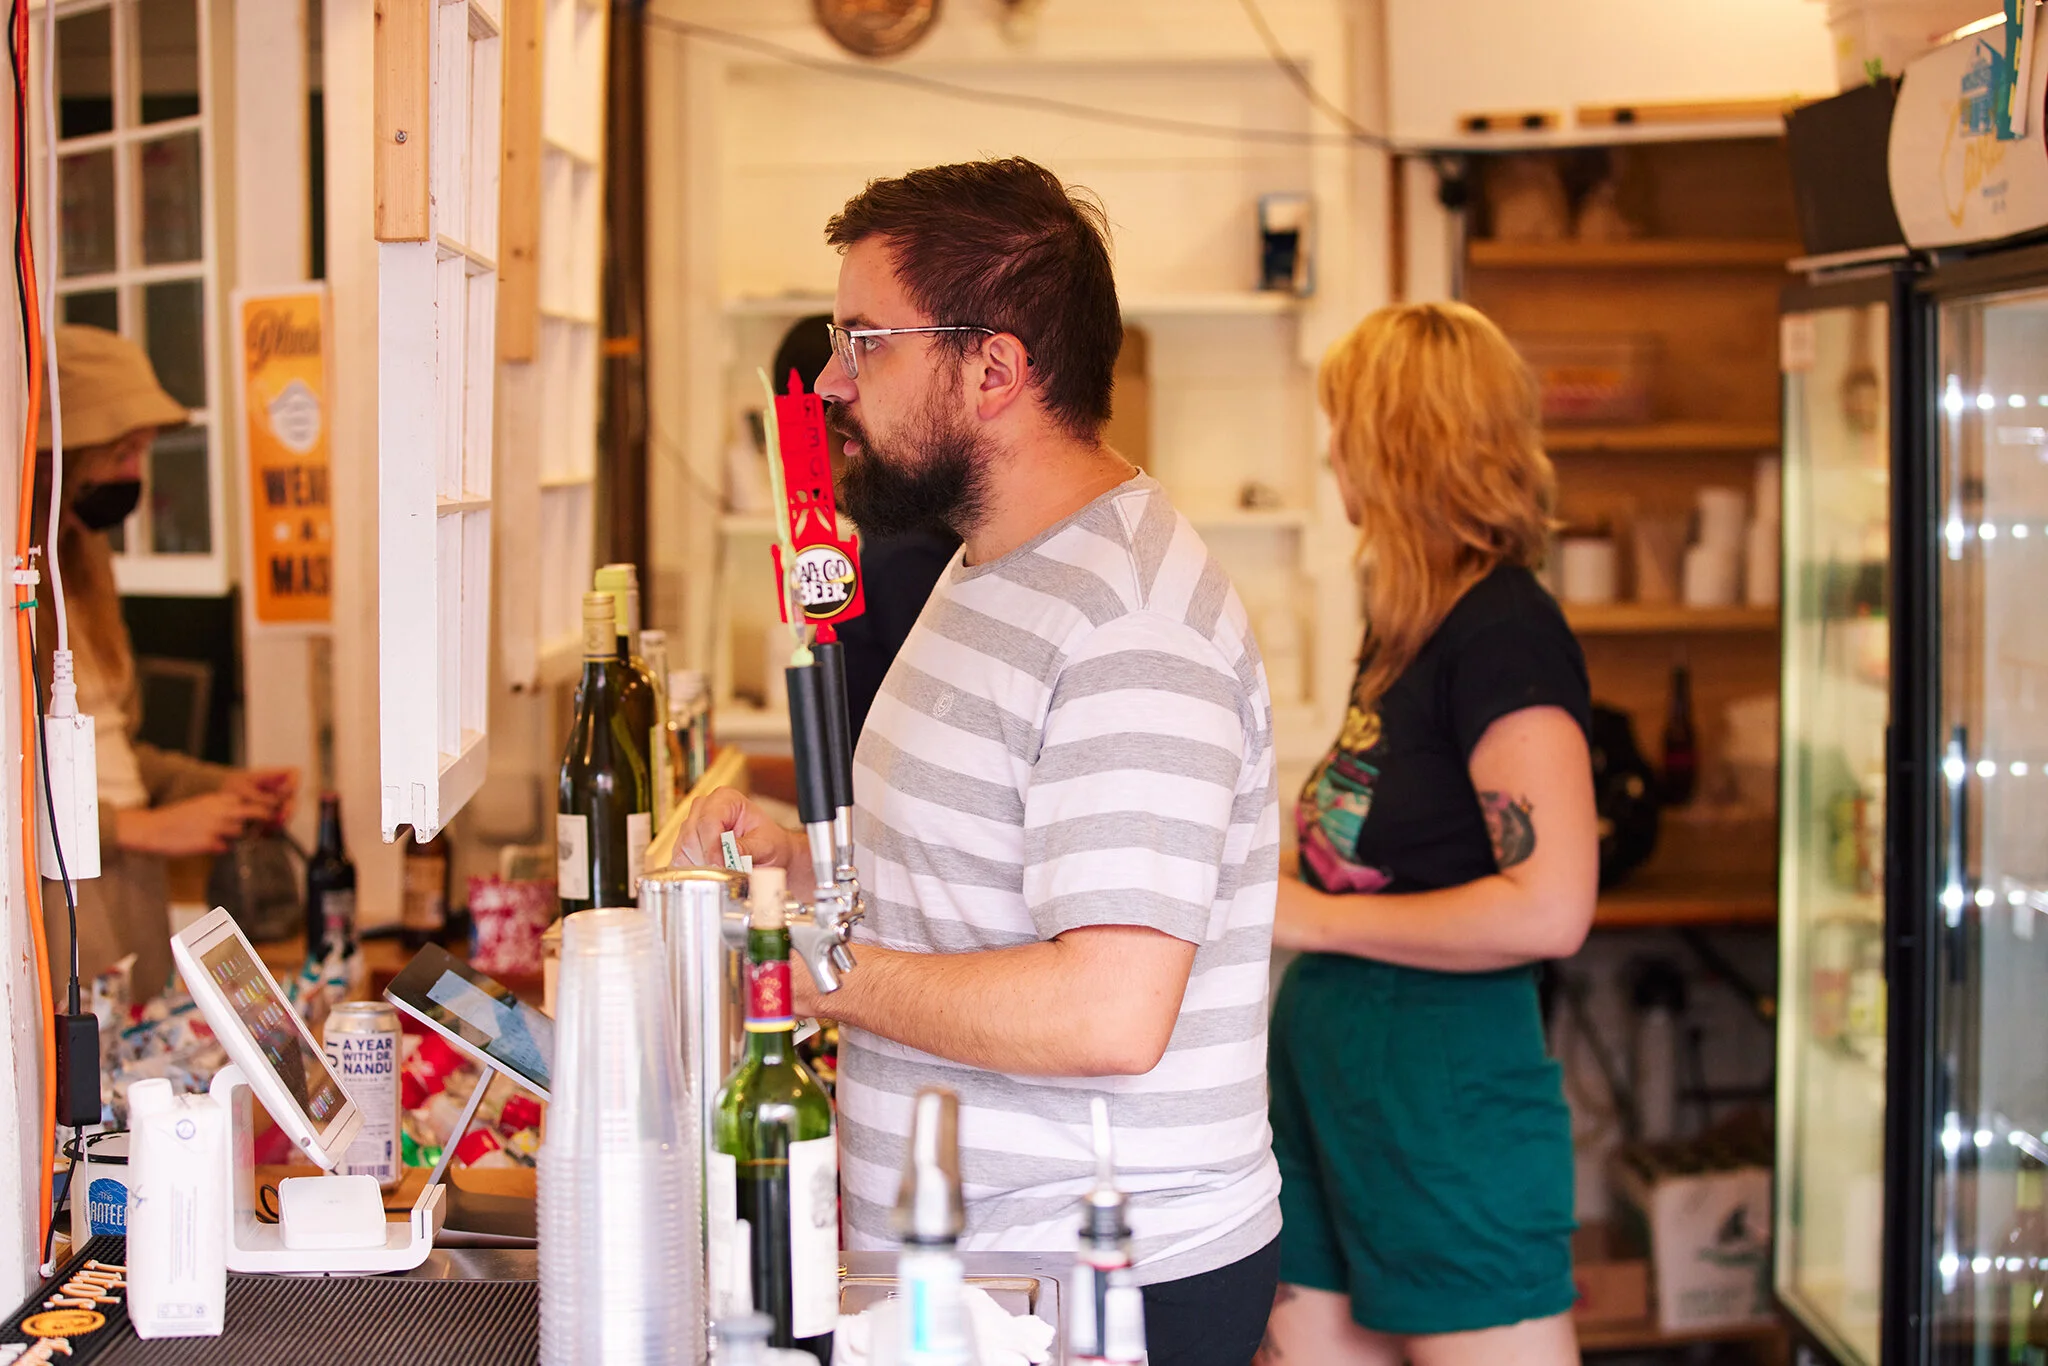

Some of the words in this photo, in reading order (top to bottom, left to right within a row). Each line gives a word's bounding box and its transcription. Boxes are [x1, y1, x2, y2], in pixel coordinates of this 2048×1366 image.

[343, 1039, 352, 1050] A
[357, 1038, 392, 1050] YEAR
[343, 1052, 372, 1061] WITH
[343, 1061, 392, 1074] NANDU
[98, 1190, 113, 1202] The
[90, 1200, 127, 1226] ANTEE
